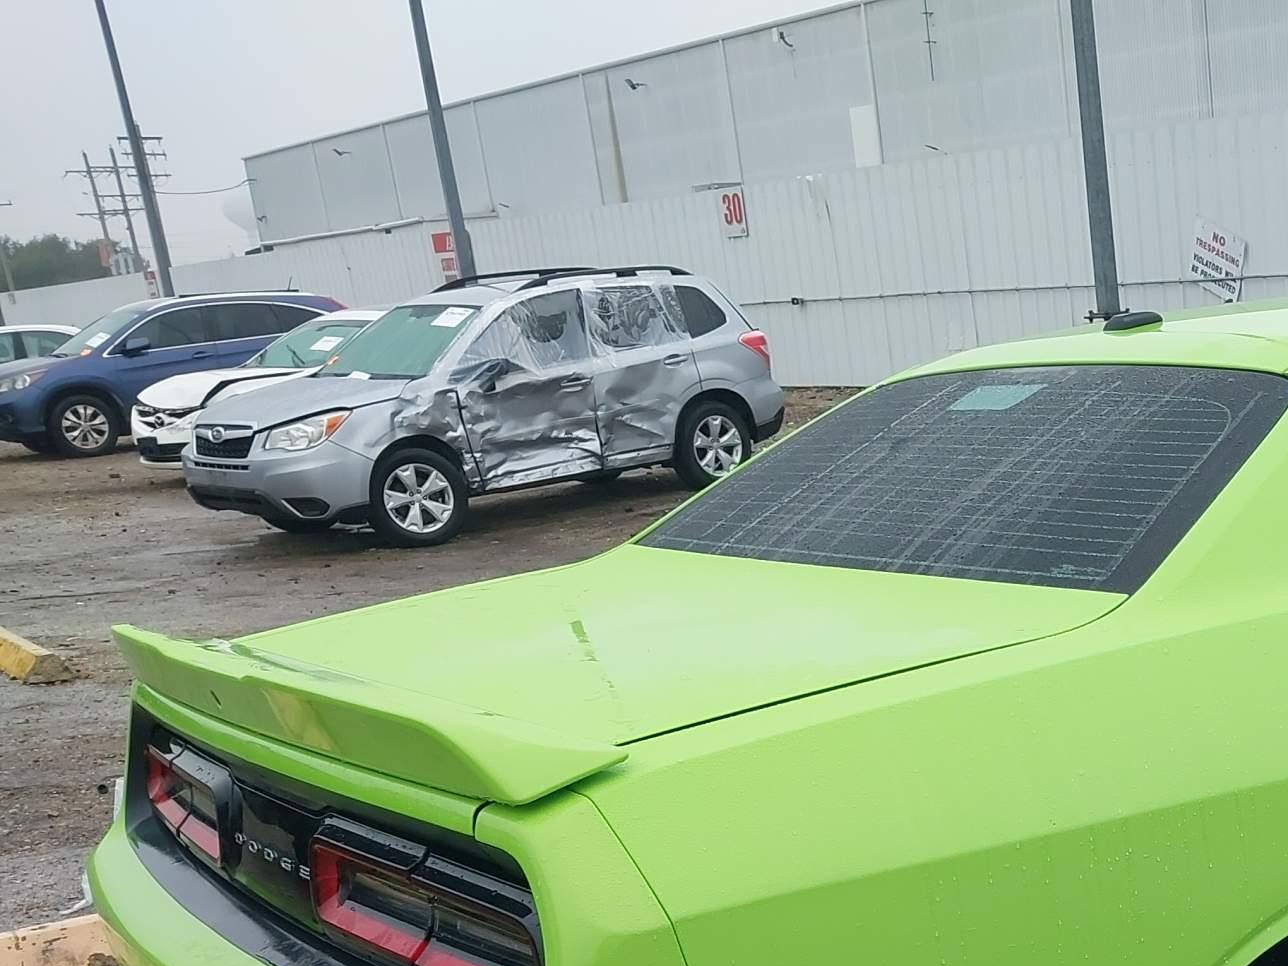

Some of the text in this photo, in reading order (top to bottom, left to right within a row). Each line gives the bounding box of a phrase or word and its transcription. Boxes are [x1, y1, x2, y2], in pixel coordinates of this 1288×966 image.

[722, 193, 743, 225] 30
[1195, 236, 1240, 268] TRESPASSING
[1212, 231, 1226, 247] NO
[1193, 252, 1223, 275] VIOLATORS
[234, 832, 311, 880] DODGE
